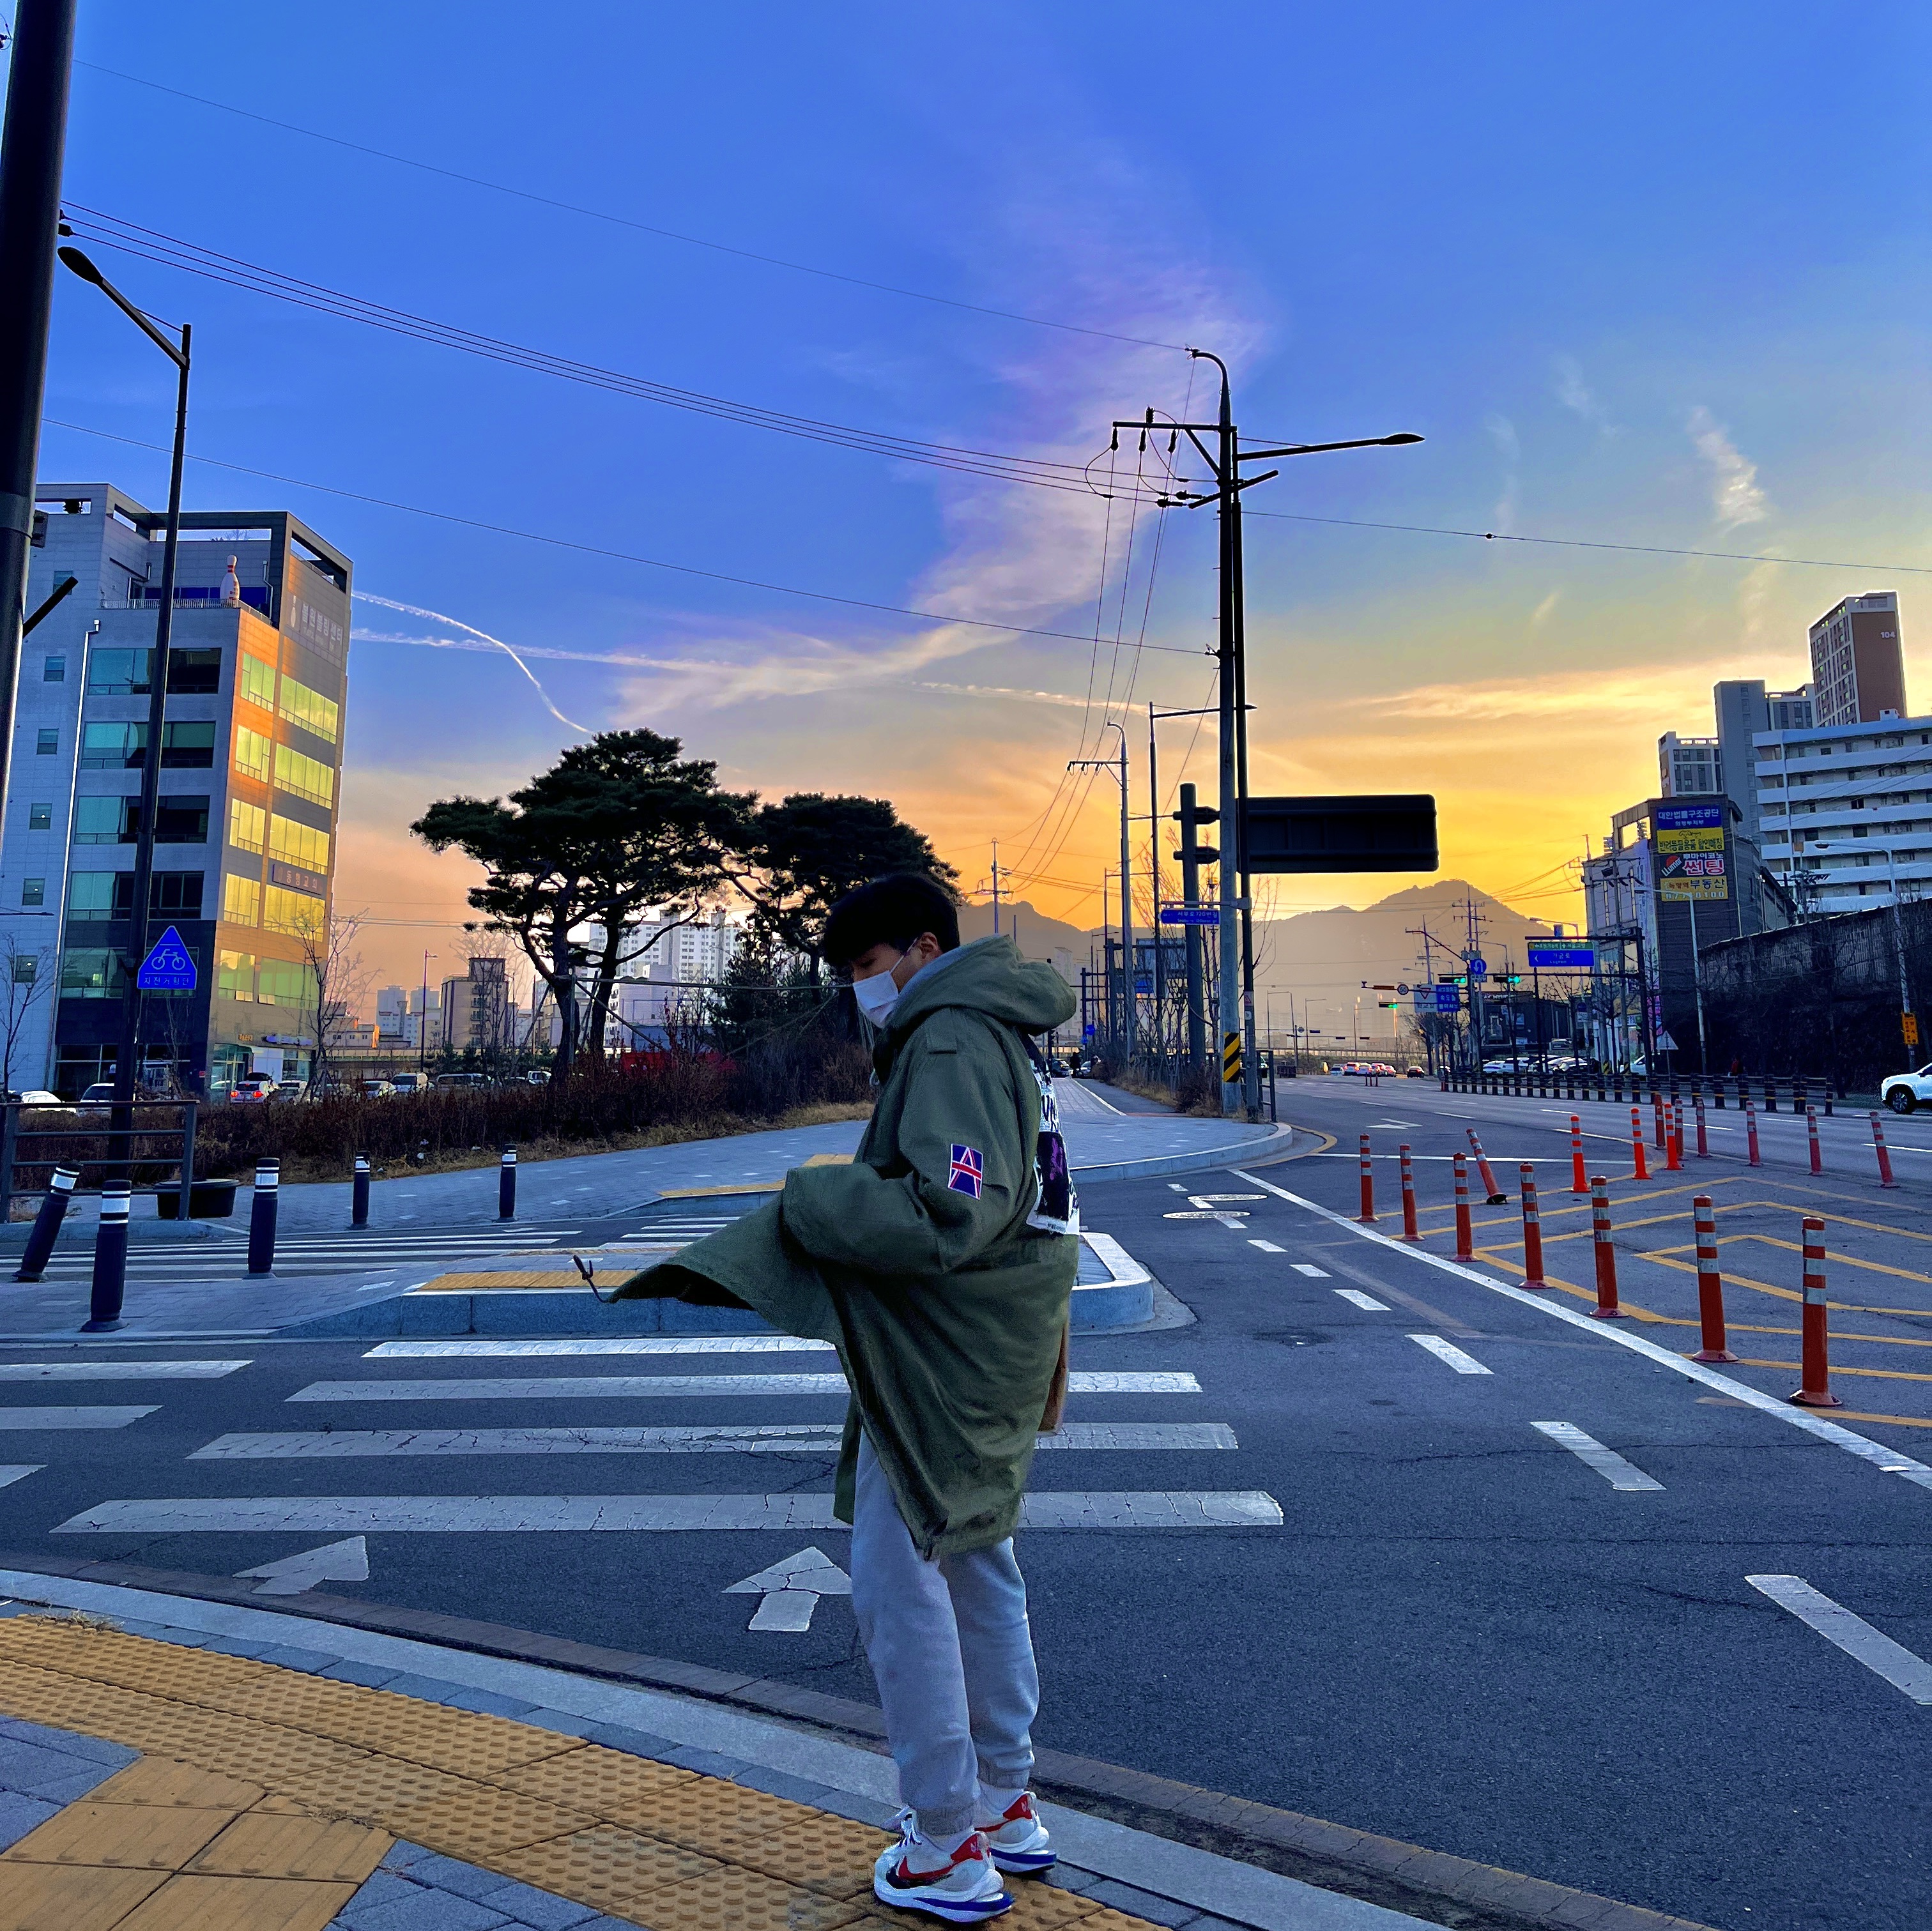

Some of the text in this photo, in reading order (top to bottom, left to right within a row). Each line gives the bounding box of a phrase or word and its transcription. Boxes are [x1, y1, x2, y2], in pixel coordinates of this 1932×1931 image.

[1658, 809, 1719, 820] 대한법률구조공단
[1682, 859, 1725, 876] 썬팅
[286, 870, 318, 890] 동행교회
[1690, 878, 1725, 890] 부동산
[144, 977, 189, 986] 자전거횡단
